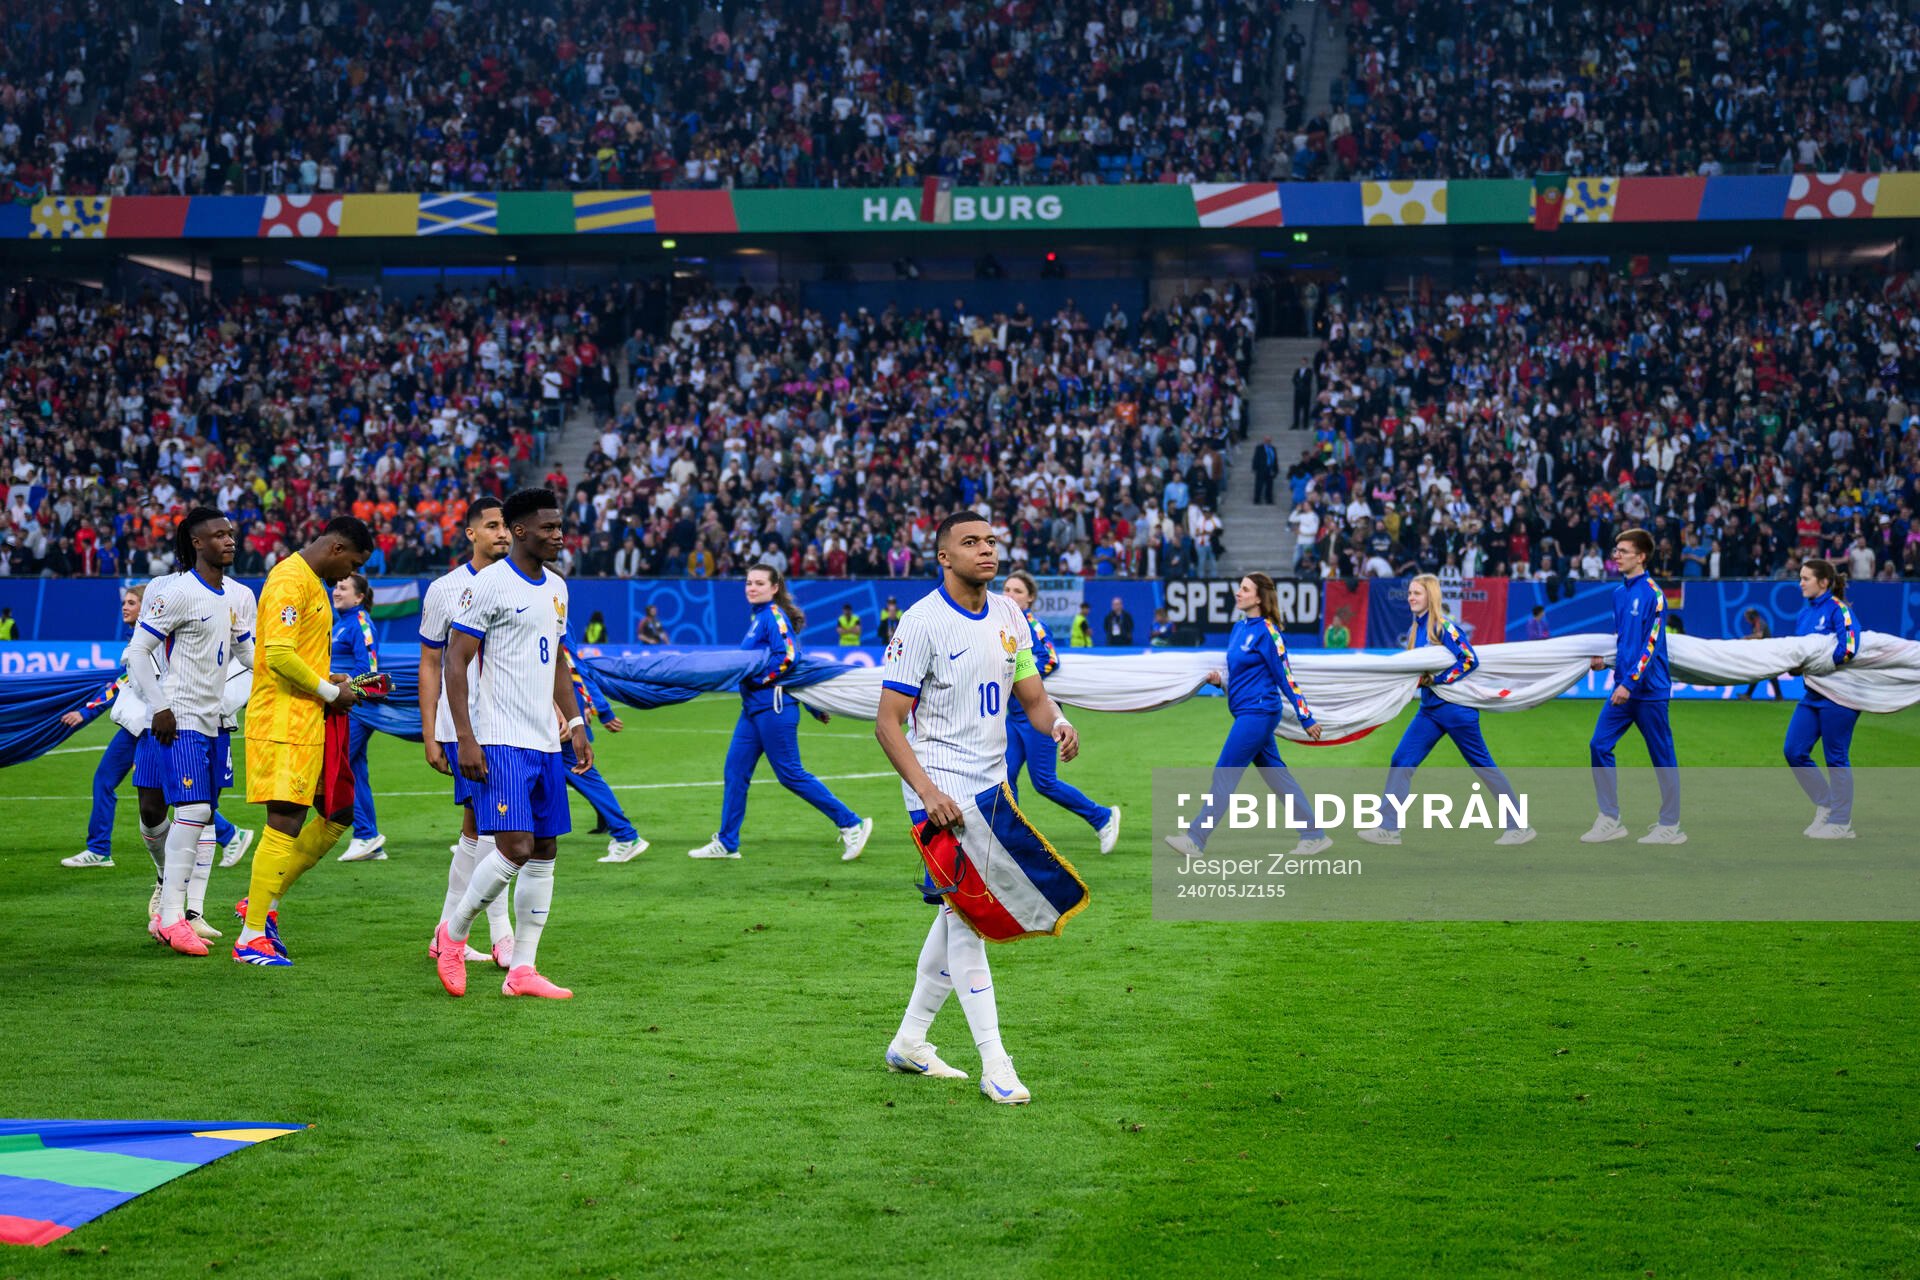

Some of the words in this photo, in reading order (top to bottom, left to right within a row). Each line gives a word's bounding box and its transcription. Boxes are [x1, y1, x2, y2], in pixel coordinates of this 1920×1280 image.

[862, 195, 1063, 222] HABURG
[1166, 580, 1319, 624] SPEXRD
[217, 641, 224, 666] 6
[539, 636, 549, 664] 8
[978, 681, 1000, 718] 10
